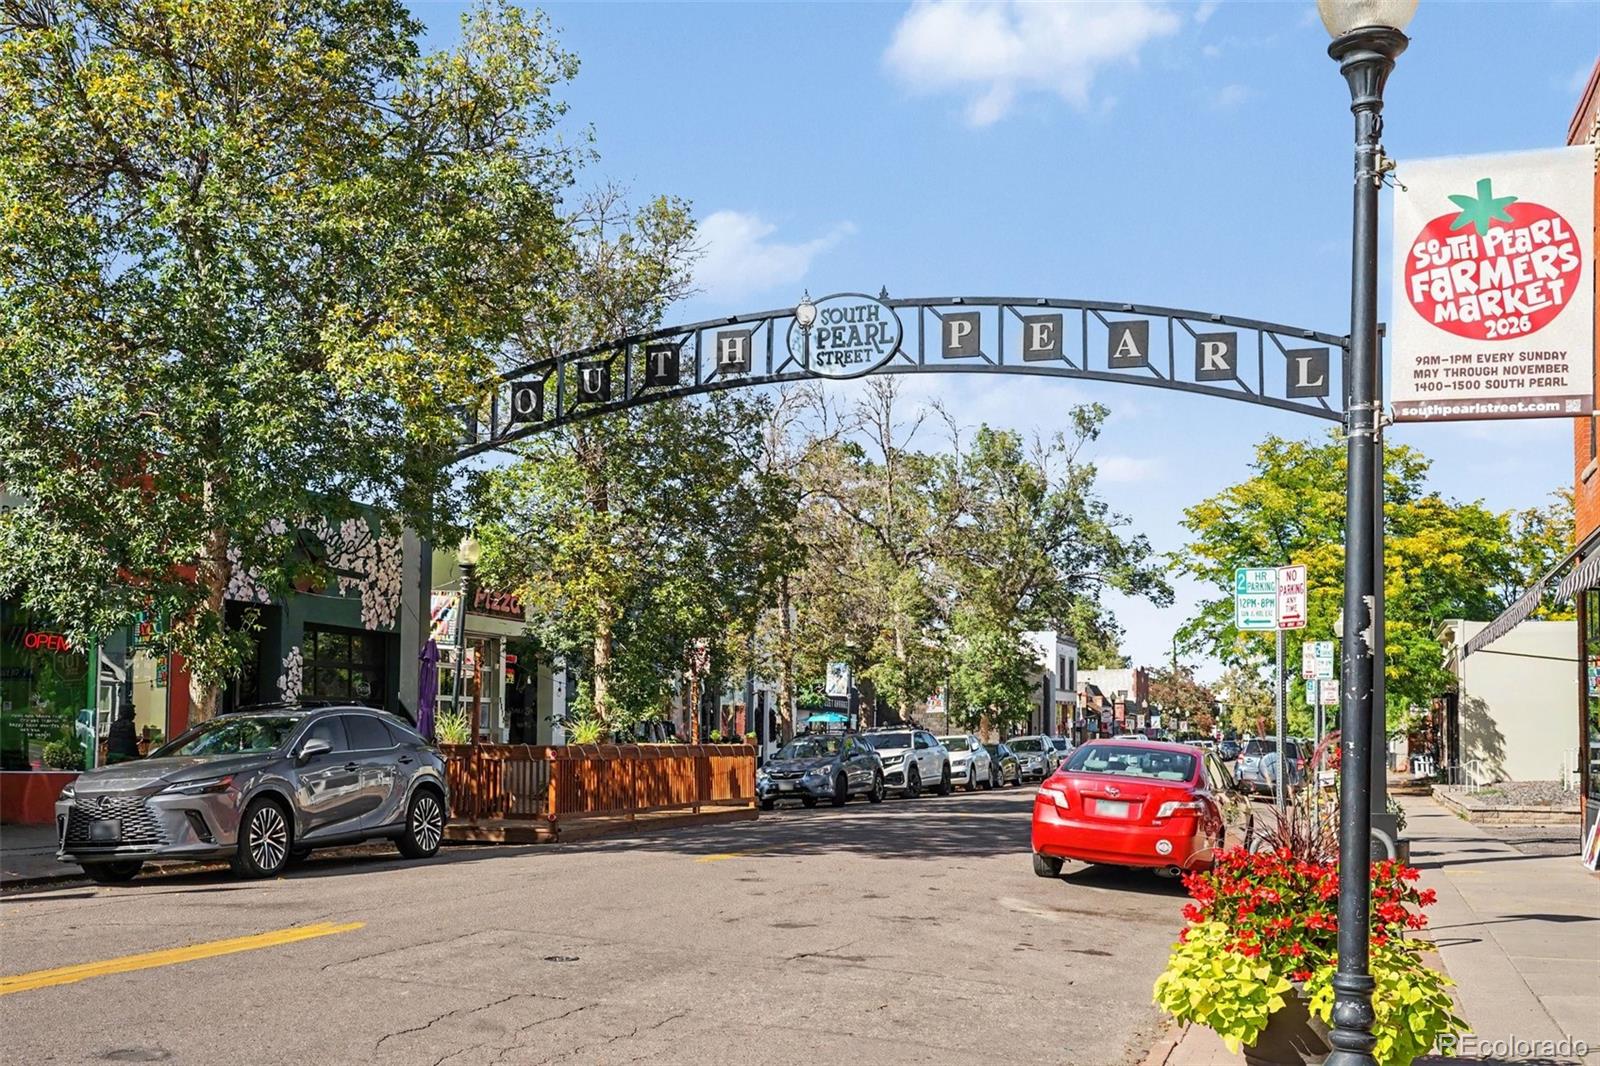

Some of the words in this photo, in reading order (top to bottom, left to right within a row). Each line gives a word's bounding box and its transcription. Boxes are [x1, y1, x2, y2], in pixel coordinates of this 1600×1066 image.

[821, 305, 880, 325] SOUTH
[1484, 316, 1532, 338] 2026
[816, 321, 894, 354] PEARL
[816, 349, 873, 367] STREET
[1477, 353, 1514, 364] EVERY
[1519, 351, 1567, 362] SUNDAY
[1413, 369, 1439, 379] MAY
[1444, 366, 1498, 378] THROUGH
[1503, 364, 1569, 375] NOVEMBER
[1485, 379, 1525, 390] SOUTH
[1529, 377, 1568, 388] PEARL
[1401, 402, 1560, 418] southpearlstreet.com
[1238, 574, 1246, 590] 2
[1255, 572, 1267, 581] HR
[1286, 569, 1297, 582] NO
[1248, 582, 1275, 591] PARKING
[1280, 583, 1304, 596] PARKING
[25, 632, 71, 652] OPEN
